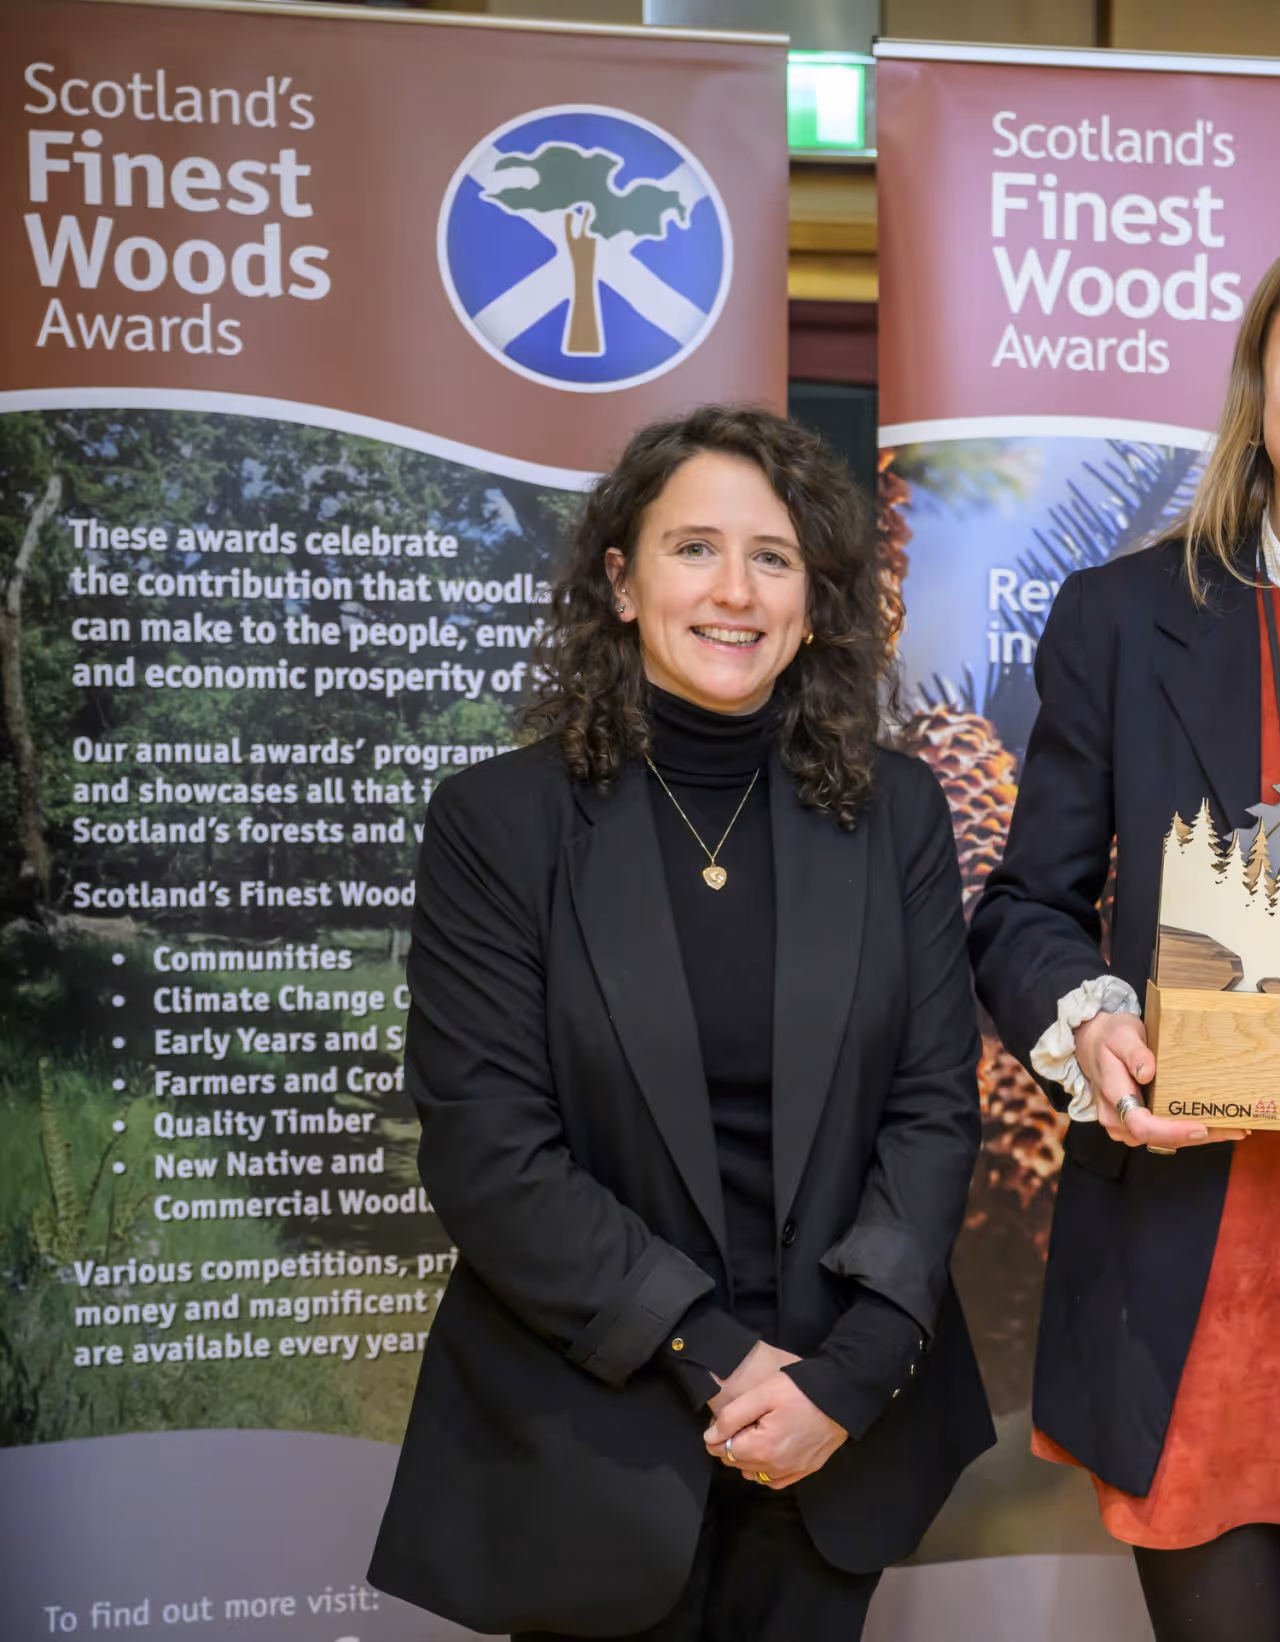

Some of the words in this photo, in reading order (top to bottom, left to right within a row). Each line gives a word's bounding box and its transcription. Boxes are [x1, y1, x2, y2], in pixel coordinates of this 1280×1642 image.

[23, 62, 315, 131] Scotland’s
[992, 111, 1235, 168] Scotland's
[27, 128, 313, 218] Finest
[991, 171, 1226, 248] Finest
[23, 213, 331, 300] Woods
[992, 247, 1243, 321] Woods
[36, 298, 243, 356] Awards
[992, 324, 1170, 374] Awards
[69, 518, 168, 550] These
[176, 522, 298, 555] awards
[305, 524, 459, 558] celebrate
[70, 566, 129, 597] the
[137, 569, 353, 601] contribution
[360, 573, 430, 603] that
[438, 573, 570, 604] woodla
[71, 617, 132, 643] can
[140, 613, 233, 645] make
[240, 619, 276, 645] to
[285, 616, 341, 647] the
[348, 617, 469, 653] people,
[72, 657, 136, 688] and
[144, 660, 307, 691] economic
[314, 662, 484, 700] prosperity
[491, 661, 527, 692] of
[73, 737, 126, 764] Our
[136, 736, 243, 765] annual
[74, 776, 130, 804] and
[138, 777, 299, 805] showcases
[306, 776, 345, 804] all
[351, 777, 416, 804] that
[238, 816, 344, 844] forests
[352, 816, 406, 844] and
[240, 880, 333, 908] Finest
[153, 944, 353, 972] Communities
[153, 986, 271, 1014] Climate
[278, 985, 386, 1018] Change
[155, 1028, 231, 1061] Early
[237, 1027, 317, 1055] Years
[324, 1025, 378, 1053] and
[155, 1069, 276, 1097] Farmers
[284, 1067, 338, 1095] and
[154, 1109, 266, 1142] Quality
[271, 1107, 376, 1137] Timber
[1168, 1101, 1252, 1118] GLENNON
[155, 1152, 218, 1180] New
[226, 1149, 322, 1178] Native
[331, 1146, 385, 1175] and
[153, 1189, 331, 1222] Commercial
[337, 1186, 436, 1216] Woodl
[73, 1259, 193, 1287] Various
[200, 1250, 408, 1283] competitions,
[75, 1302, 177, 1330] money
[183, 1293, 240, 1322] and
[248, 1288, 428, 1325] magnificent
[73, 1343, 123, 1368] are
[132, 1334, 270, 1364] available
[279, 1332, 359, 1361] every
[45, 1606, 78, 1634] To
[90, 1597, 150, 1629] find
[162, 1597, 214, 1625] out
[224, 1592, 297, 1620] more
[306, 1585, 380, 1615] visit:
